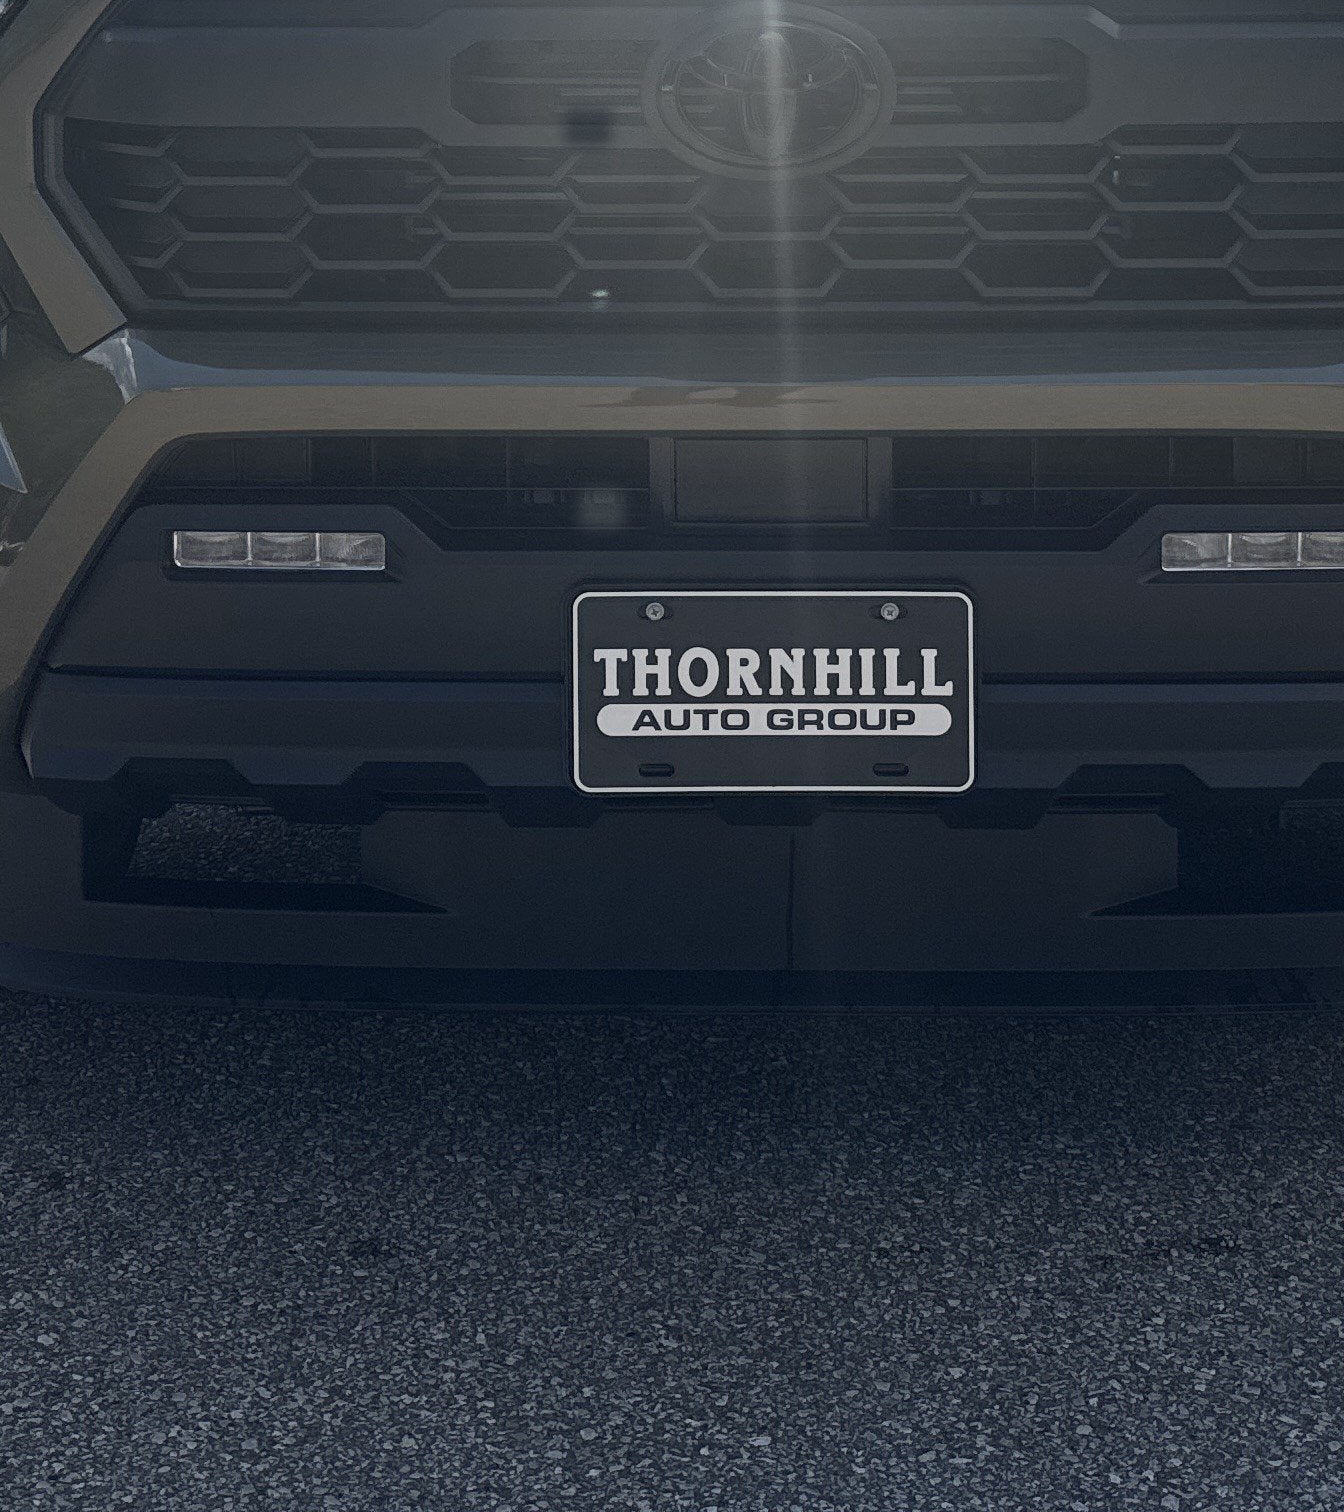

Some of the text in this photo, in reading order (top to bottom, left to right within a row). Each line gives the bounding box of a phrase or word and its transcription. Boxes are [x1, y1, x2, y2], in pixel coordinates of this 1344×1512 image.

[593, 646, 953, 698] THORNHILL
[632, 709, 916, 731] AUTO GROUP
